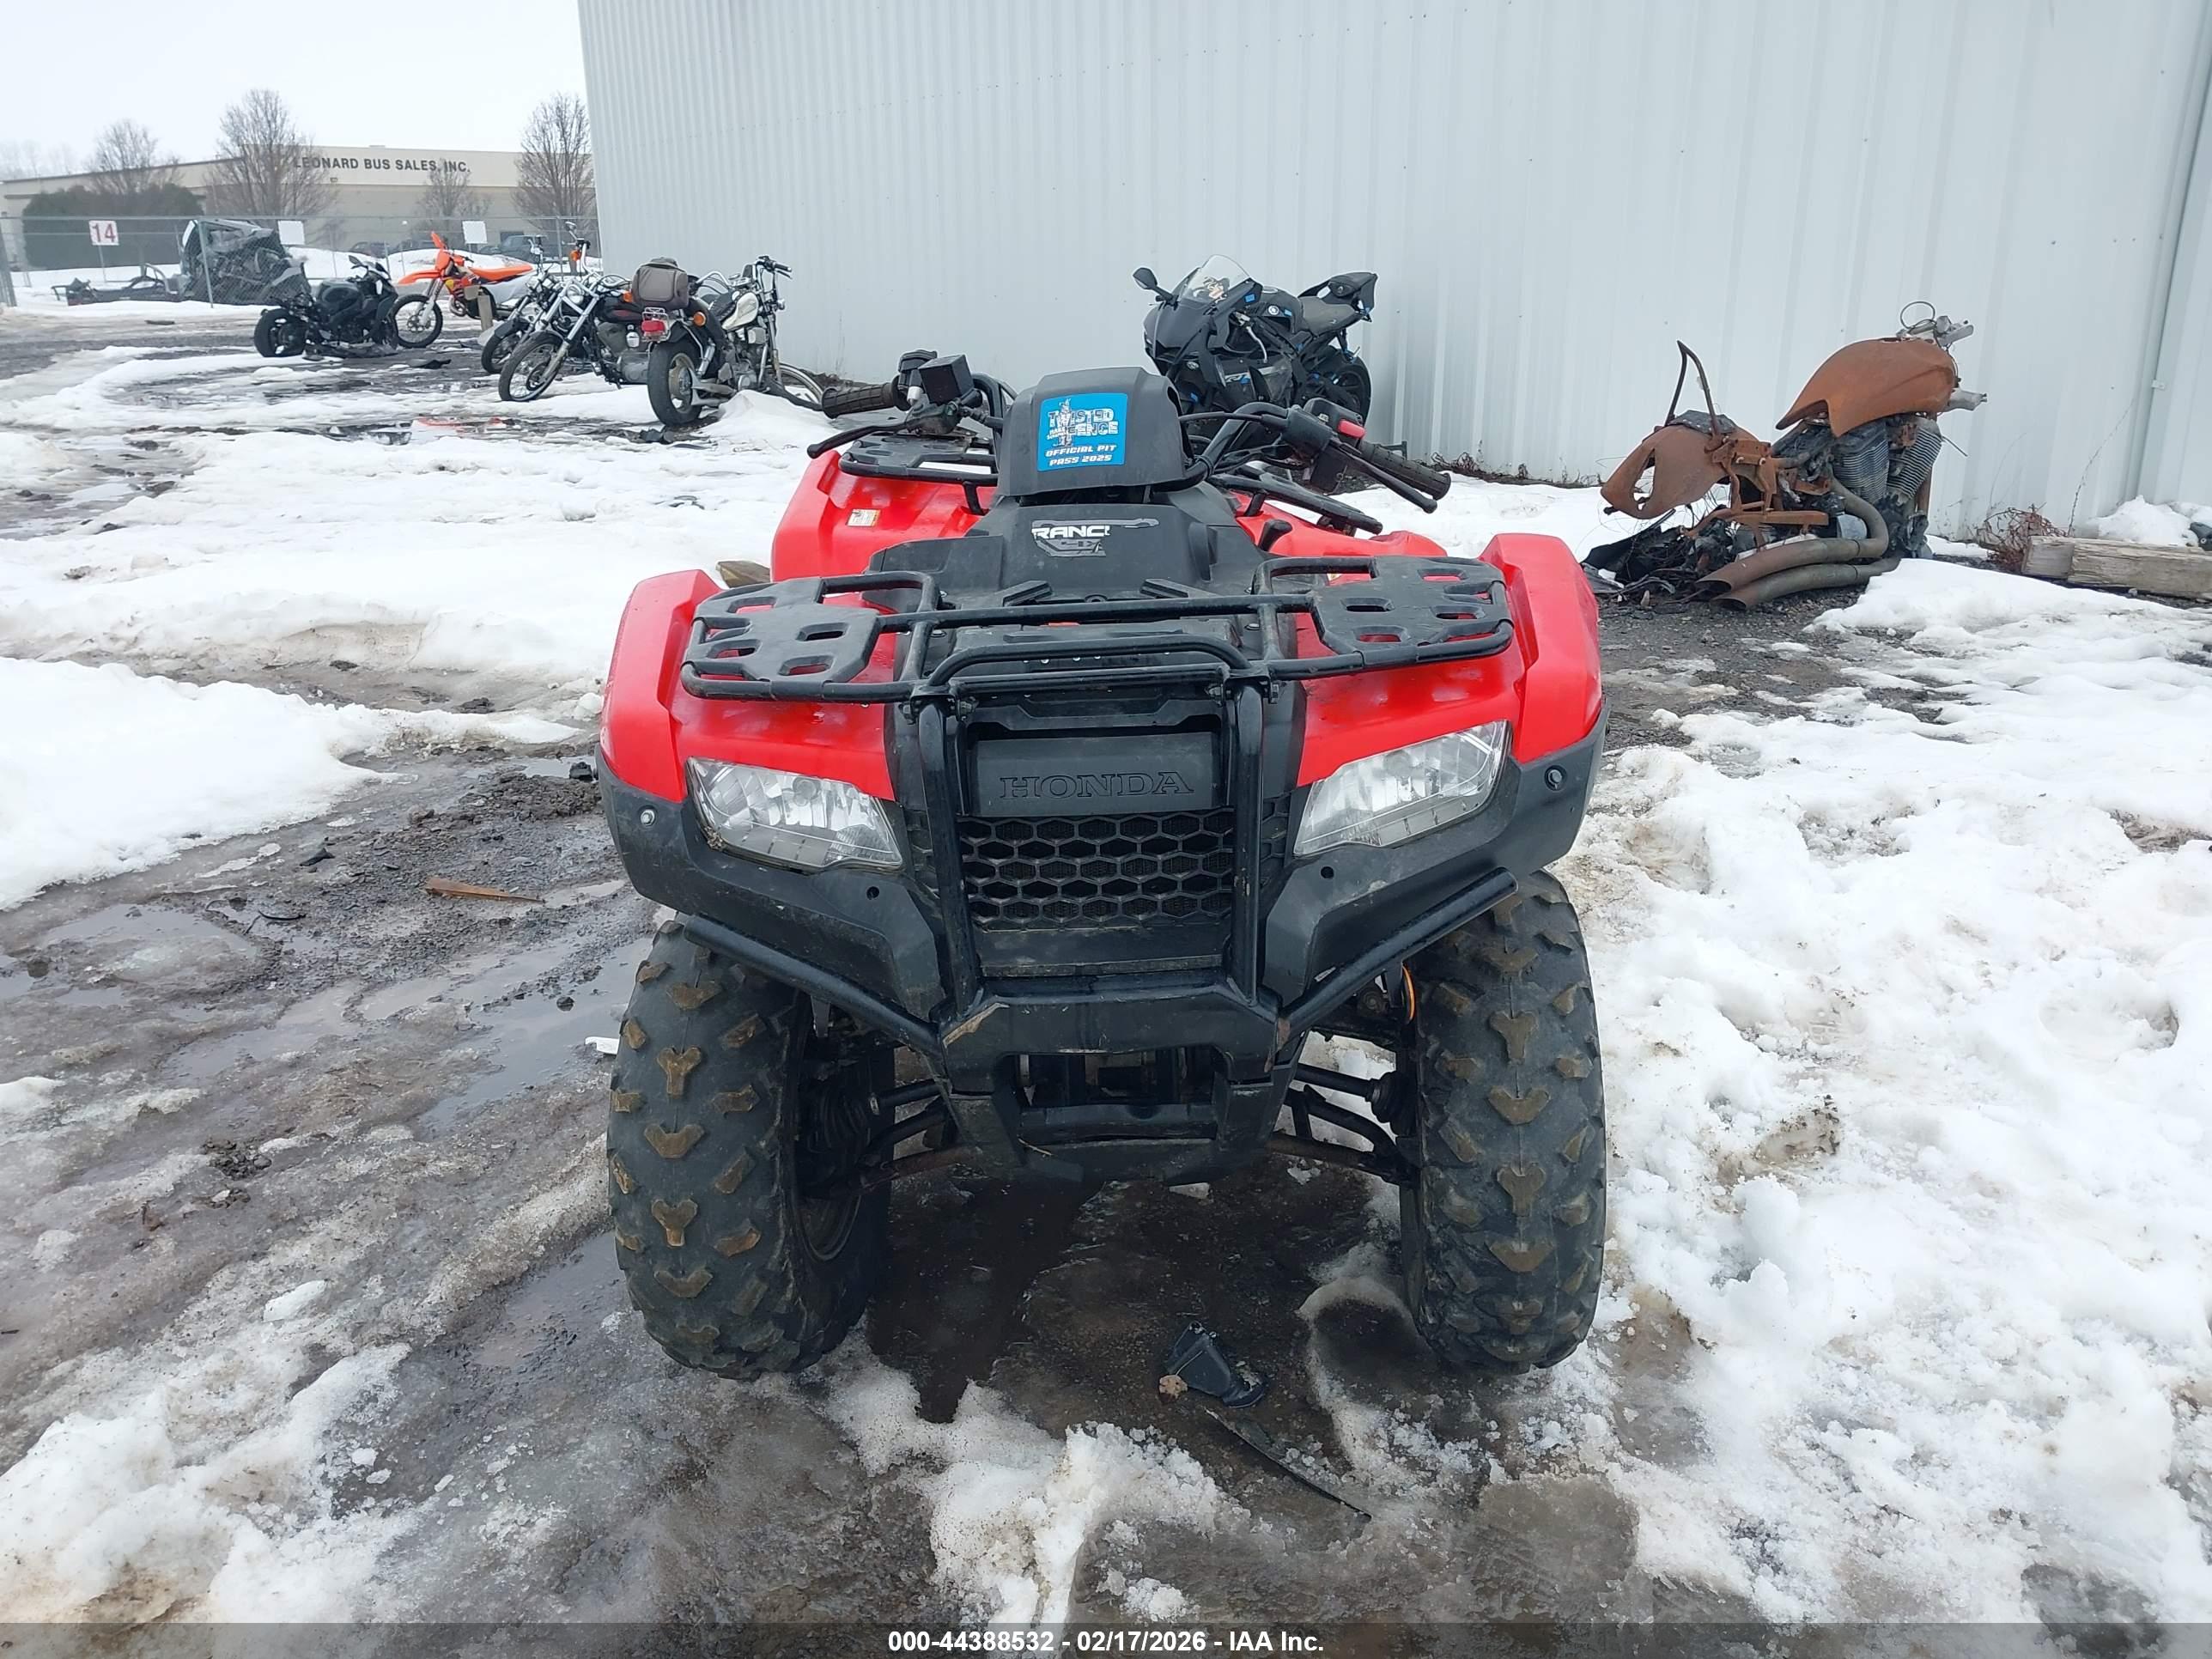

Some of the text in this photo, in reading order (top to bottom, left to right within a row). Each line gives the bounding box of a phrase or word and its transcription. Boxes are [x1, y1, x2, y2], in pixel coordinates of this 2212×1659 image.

[295, 157, 359, 169] LEONARD
[363, 158, 391, 170] BUS
[444, 160, 471, 173] INC.
[92, 223, 116, 242] 14
[1048, 408, 1114, 428] TWISTED
[1045, 446, 1094, 458] OFFICIAL
[1048, 454, 1113, 466] PASS 2025
[1000, 771, 1195, 799] HONDA
